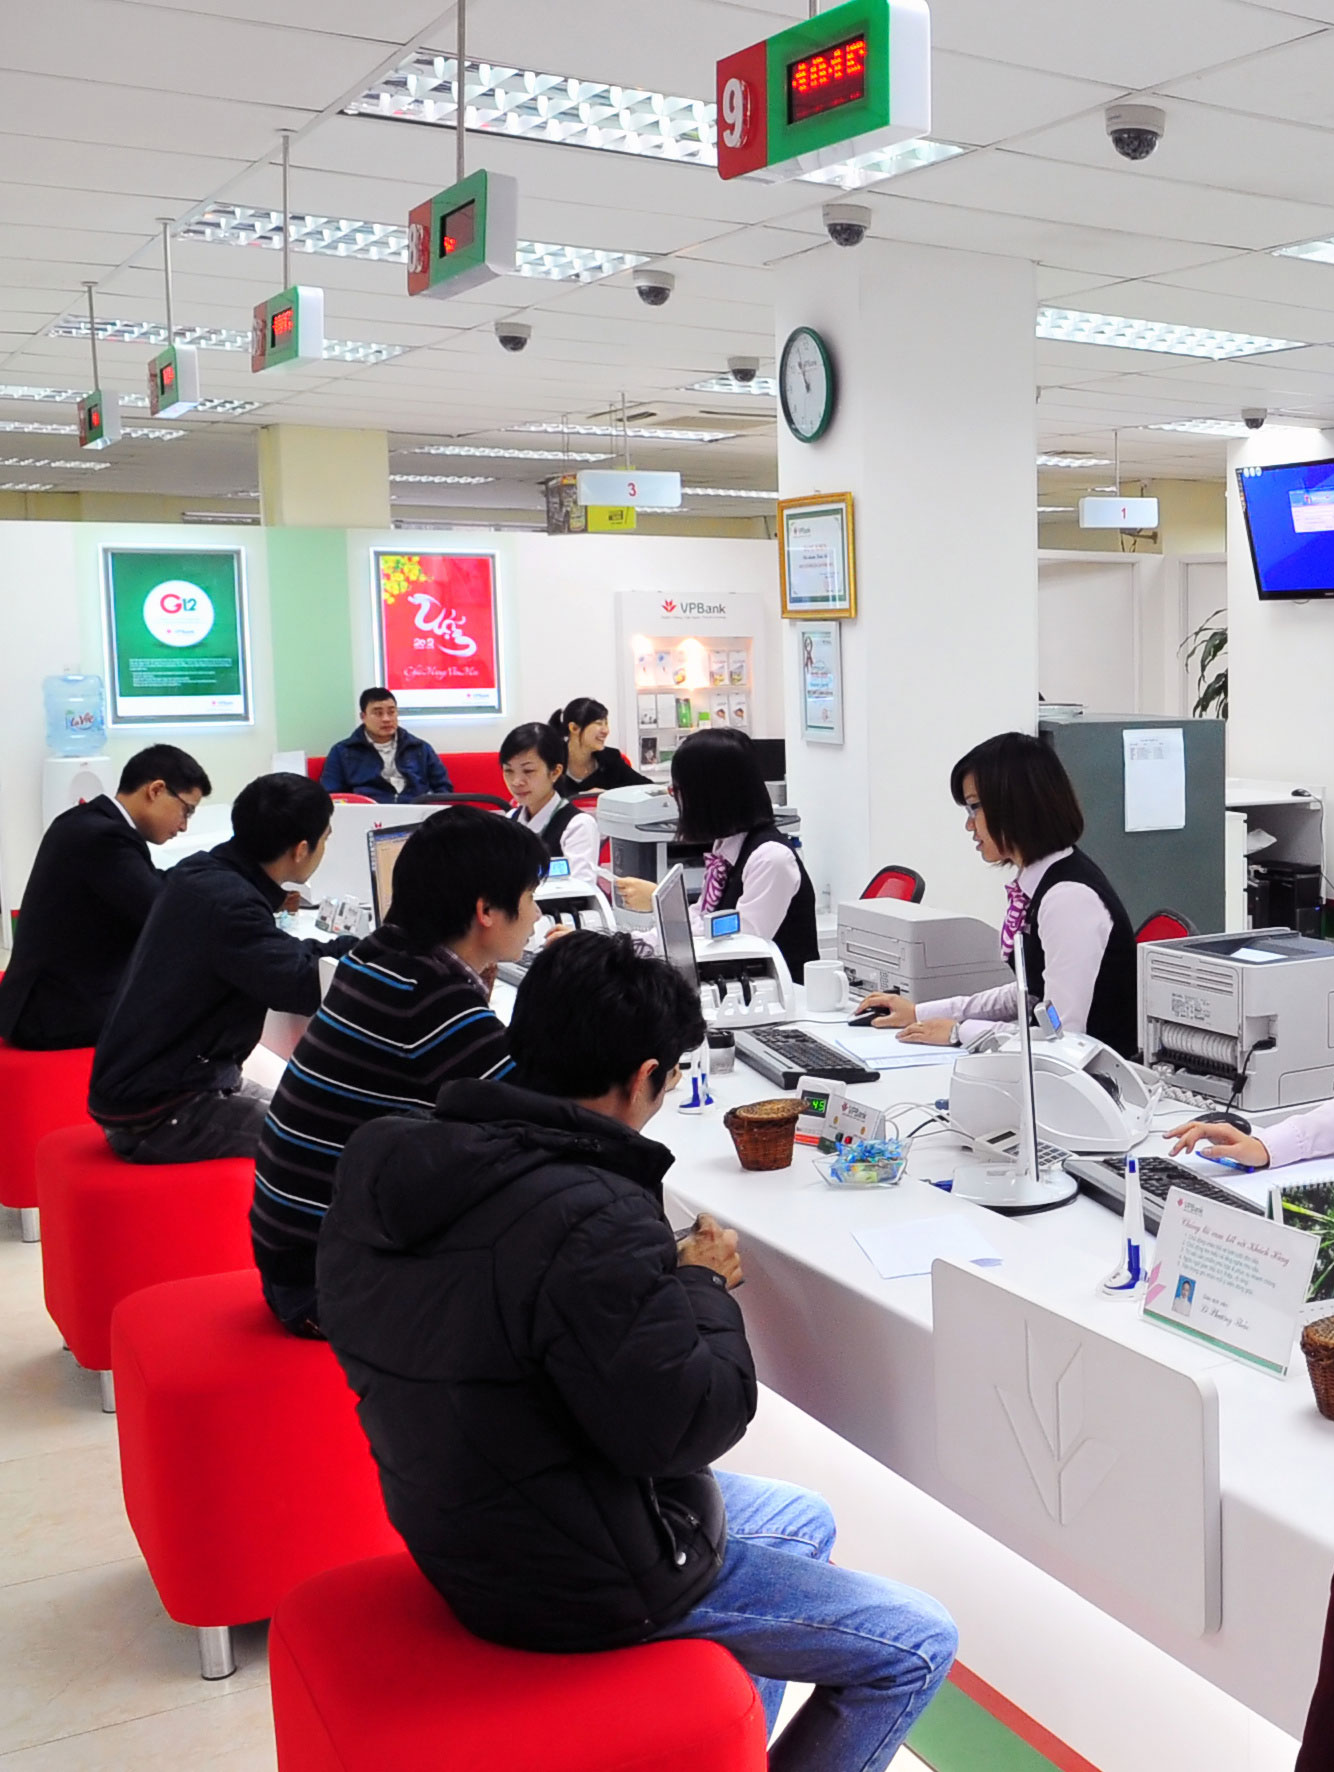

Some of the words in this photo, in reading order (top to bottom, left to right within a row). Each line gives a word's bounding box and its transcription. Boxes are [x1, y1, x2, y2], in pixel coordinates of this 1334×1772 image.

[723, 78, 750, 148] 9
[627, 482, 637, 497] 3
[1121, 507, 1127, 520] 1
[160, 593, 197, 614] G12
[680, 602, 726, 614] VPBank
